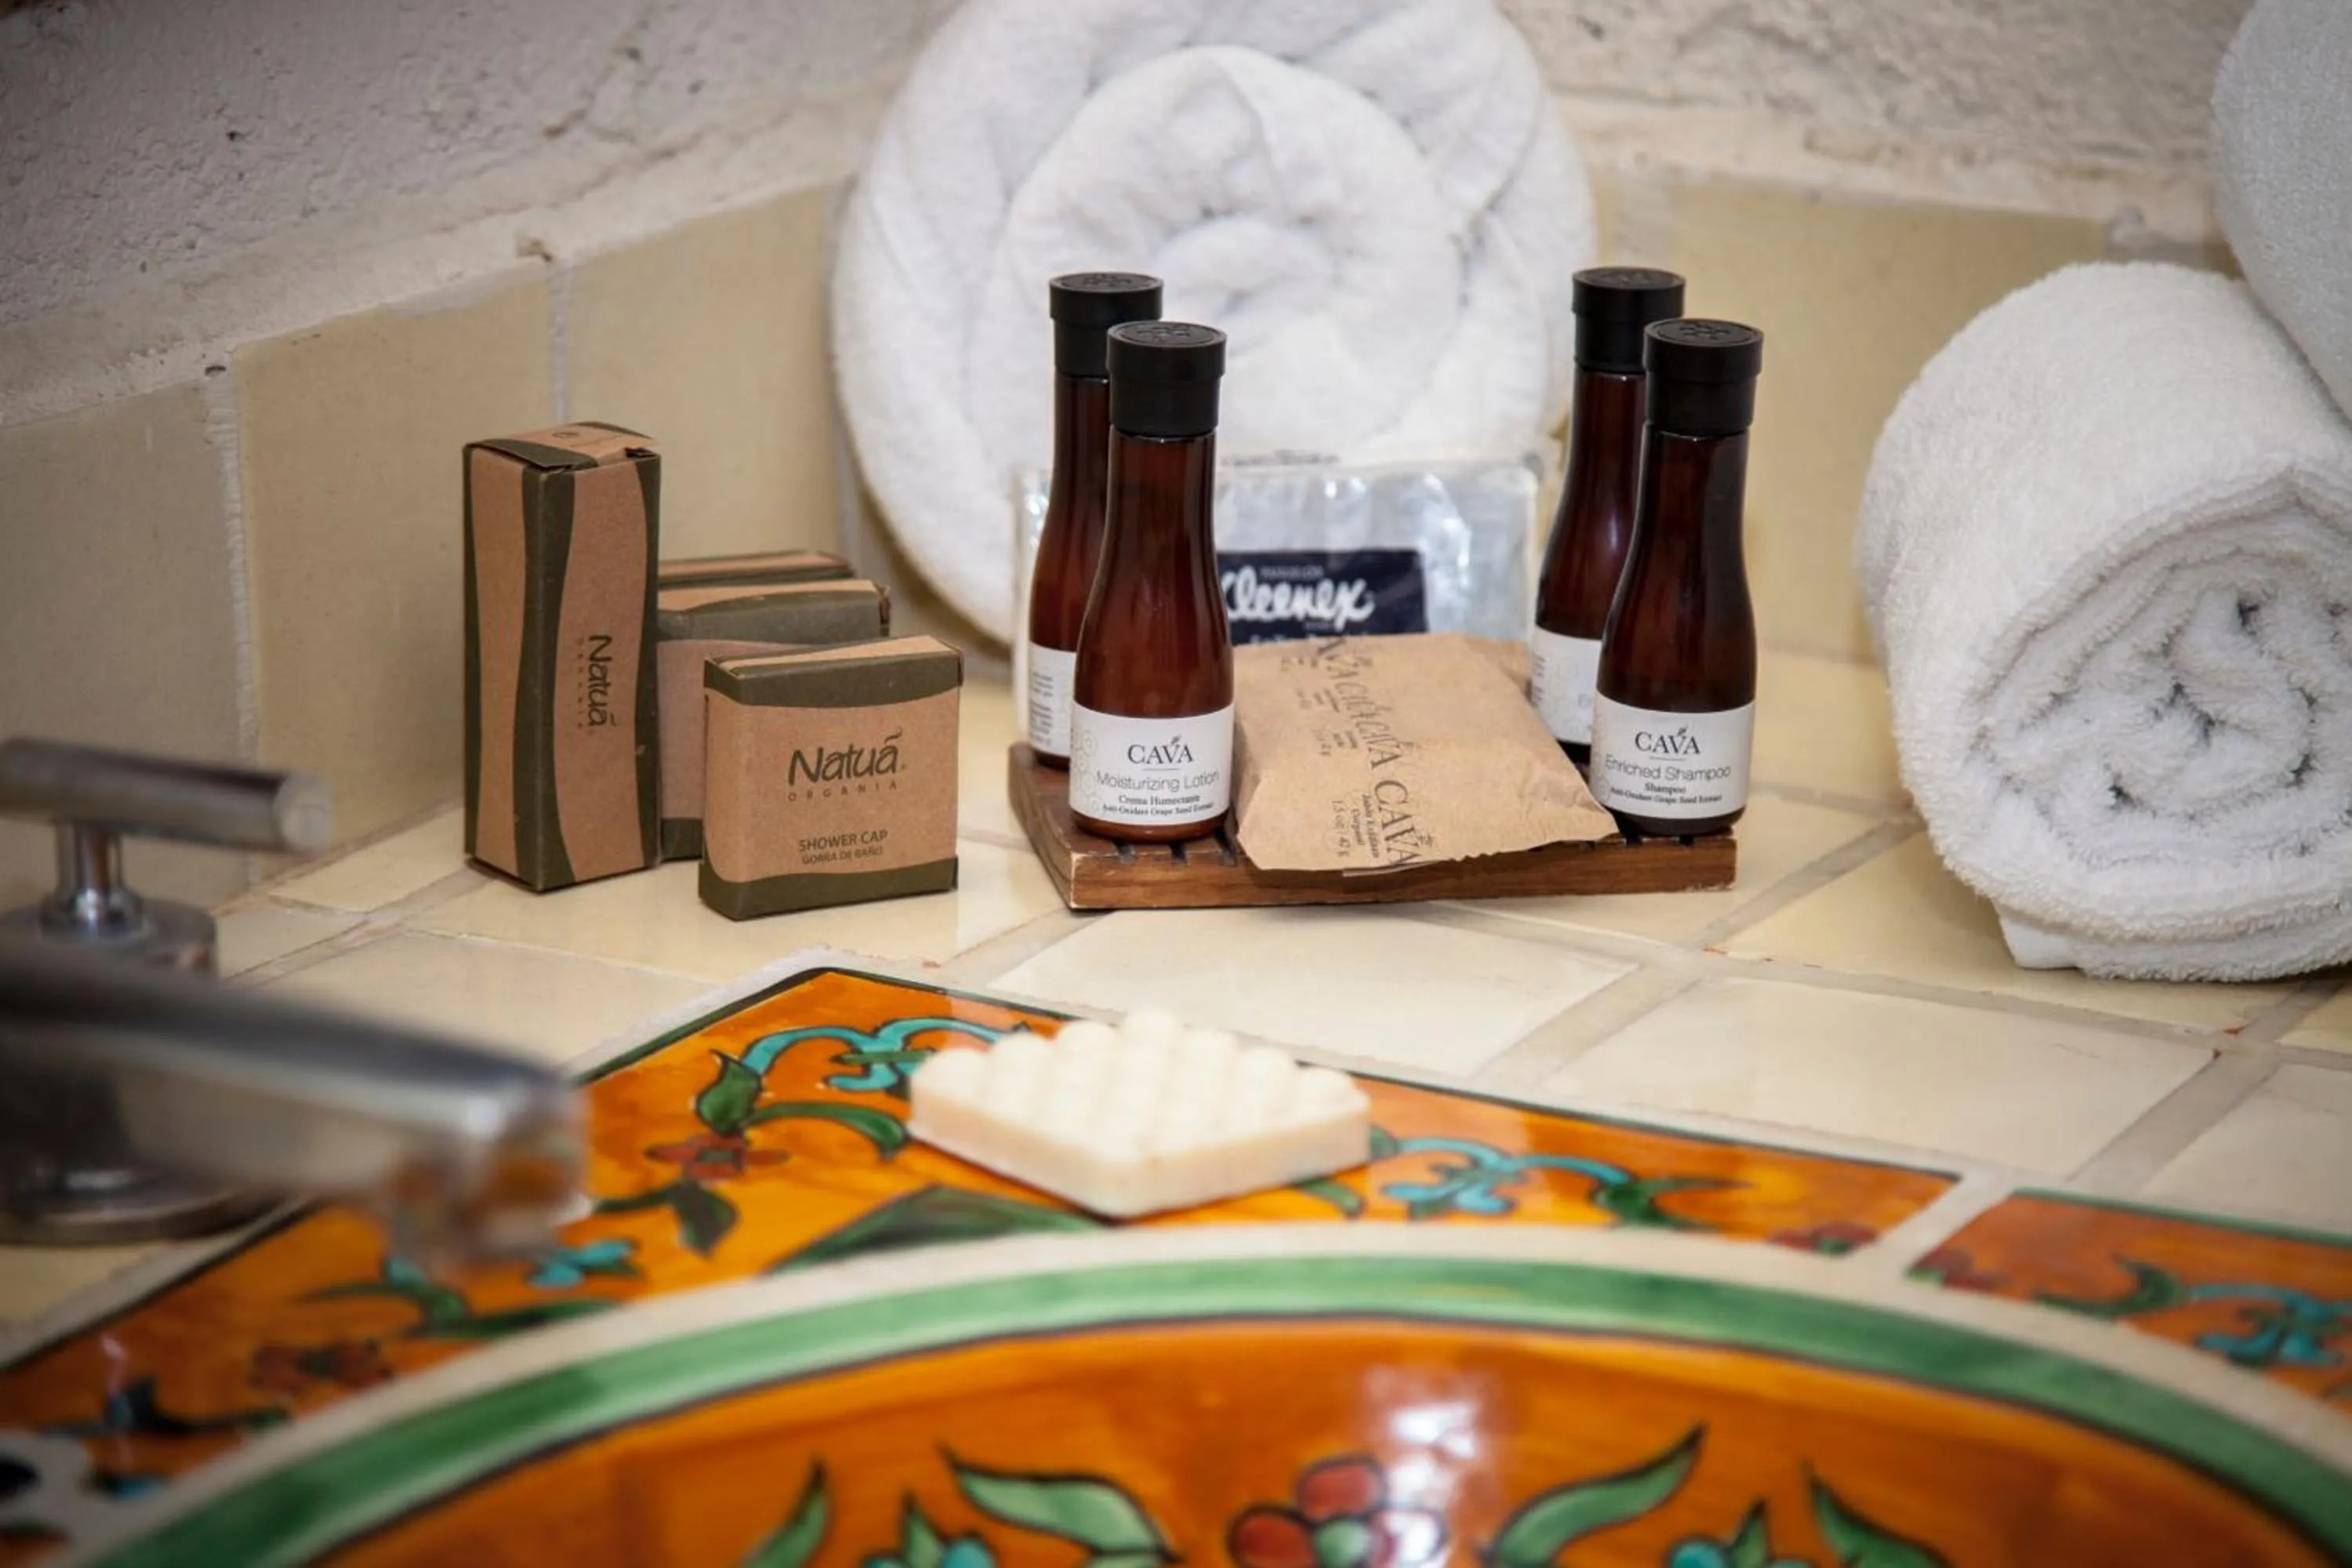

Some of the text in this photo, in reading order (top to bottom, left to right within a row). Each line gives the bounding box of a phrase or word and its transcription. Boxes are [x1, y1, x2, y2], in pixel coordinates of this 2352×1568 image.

[1127, 744, 1193, 764] CAVA
[1635, 731, 1701, 754] CAVA
[1606, 754, 1731, 782] Enriched Shampoo
[1097, 769, 1219, 793] Moisturizing Lotion
[1645, 782, 1686, 795] Shampoo
[1374, 779, 1424, 865] CAVA
[799, 829, 888, 852] SHOWER CAP
